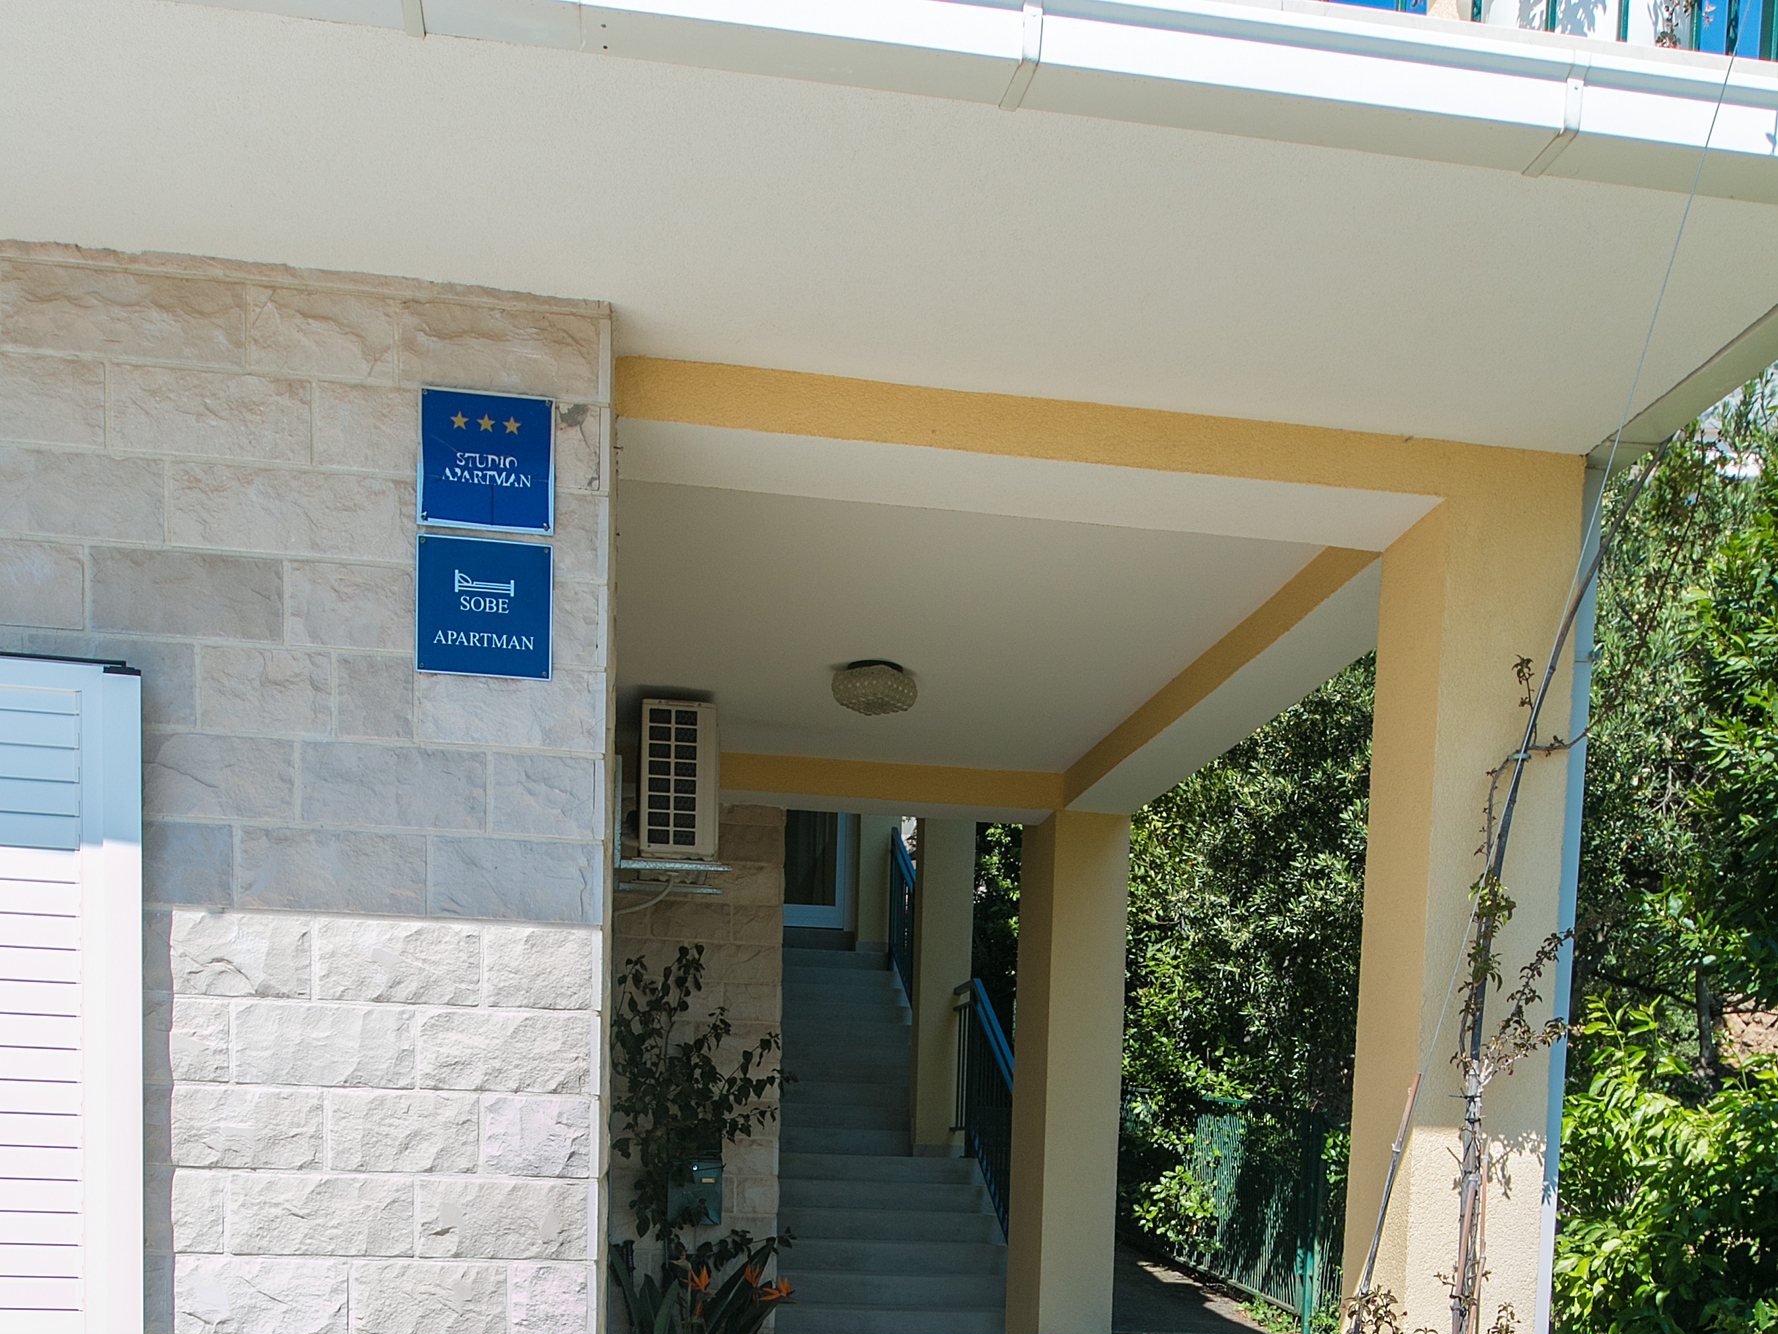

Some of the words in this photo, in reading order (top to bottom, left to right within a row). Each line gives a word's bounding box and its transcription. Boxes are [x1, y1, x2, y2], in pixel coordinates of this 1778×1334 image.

[456, 452, 518, 469] STUDIO
[460, 595, 510, 614] SOBE
[433, 630, 535, 651] APARTMAN
